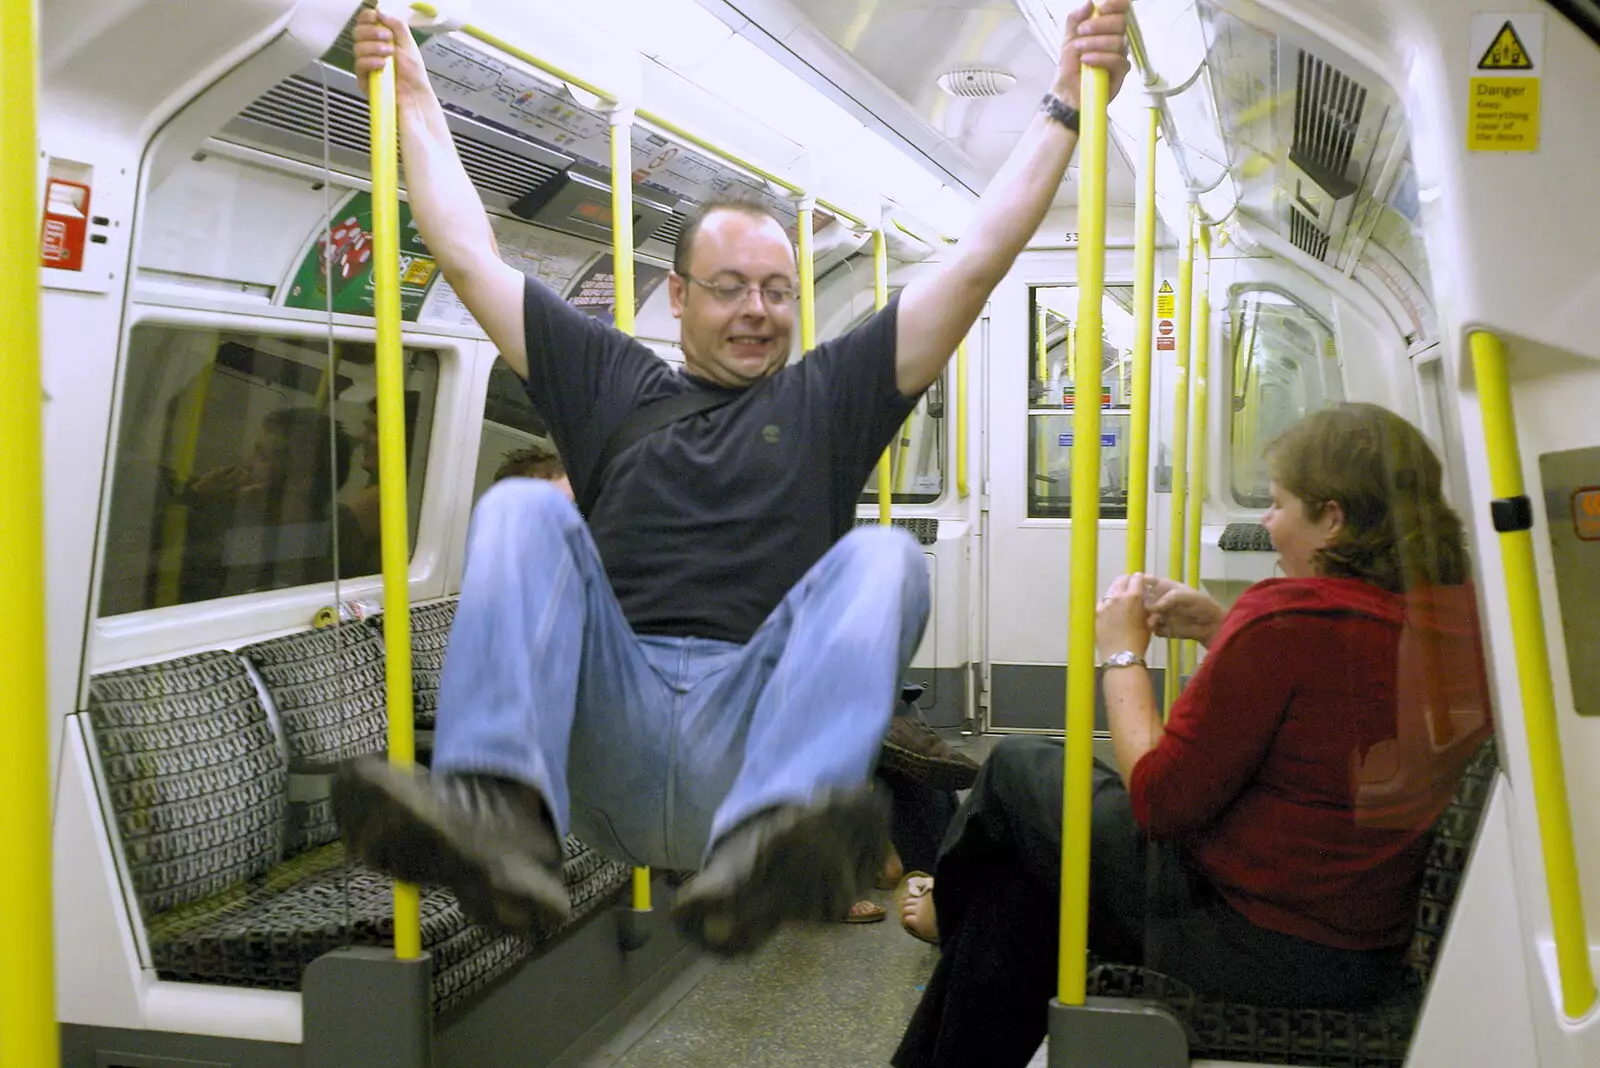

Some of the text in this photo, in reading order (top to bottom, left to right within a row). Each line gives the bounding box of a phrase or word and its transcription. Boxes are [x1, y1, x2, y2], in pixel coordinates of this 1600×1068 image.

[1476, 84, 1526, 99] Danger
[1476, 100, 1502, 110] Keep
[1476, 111, 1530, 122] everything
[1503, 121, 1515, 130] of
[1475, 132, 1524, 142] the doors
